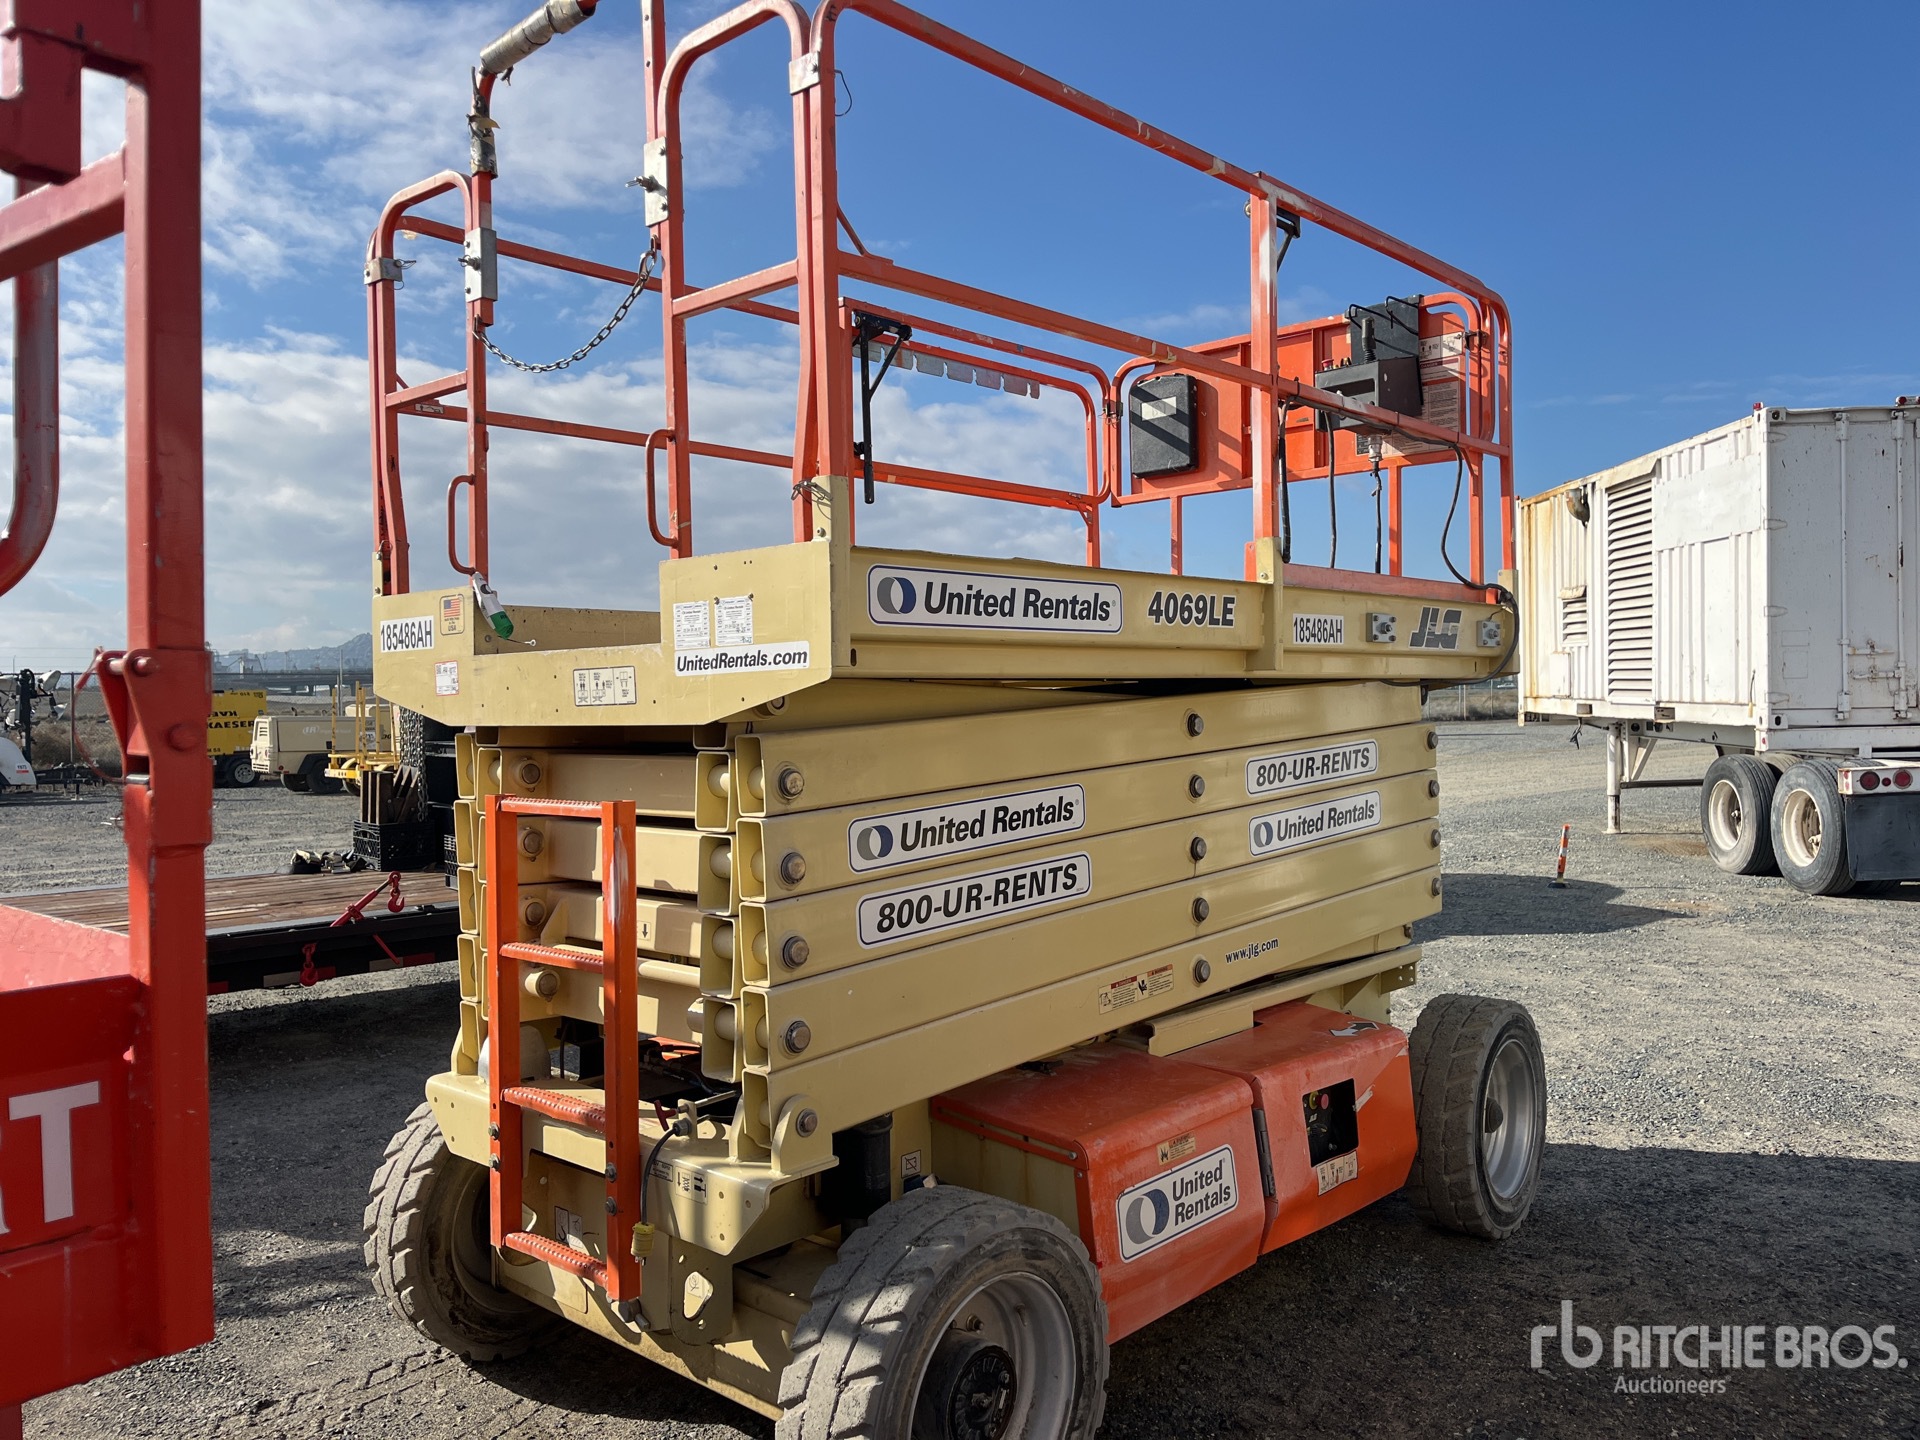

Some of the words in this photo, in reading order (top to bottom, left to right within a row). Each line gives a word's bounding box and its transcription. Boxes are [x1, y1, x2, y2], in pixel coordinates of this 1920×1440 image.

[924, 581, 1016, 617] United
[1022, 588, 1110, 621] Rentals
[1148, 591, 1236, 627] 4069LE
[381, 620, 433, 651] 185486AH
[1293, 616, 1344, 643] 185486AH
[1410, 607, 1461, 649] JLG
[677, 650, 807, 672] UnitedRentals.com
[1256, 747, 1370, 787] 800-UR-RENTS
[901, 809, 986, 852] United
[992, 796, 1074, 834] Rentals
[1276, 810, 1323, 842] United
[1327, 800, 1375, 829] Rentals
[876, 863, 1078, 934] 800-UR-RENTS
[1225, 938, 1279, 963] www.jlg.com
[1172, 1160, 1223, 1200] United
[1174, 1184, 1231, 1226] Rentals
